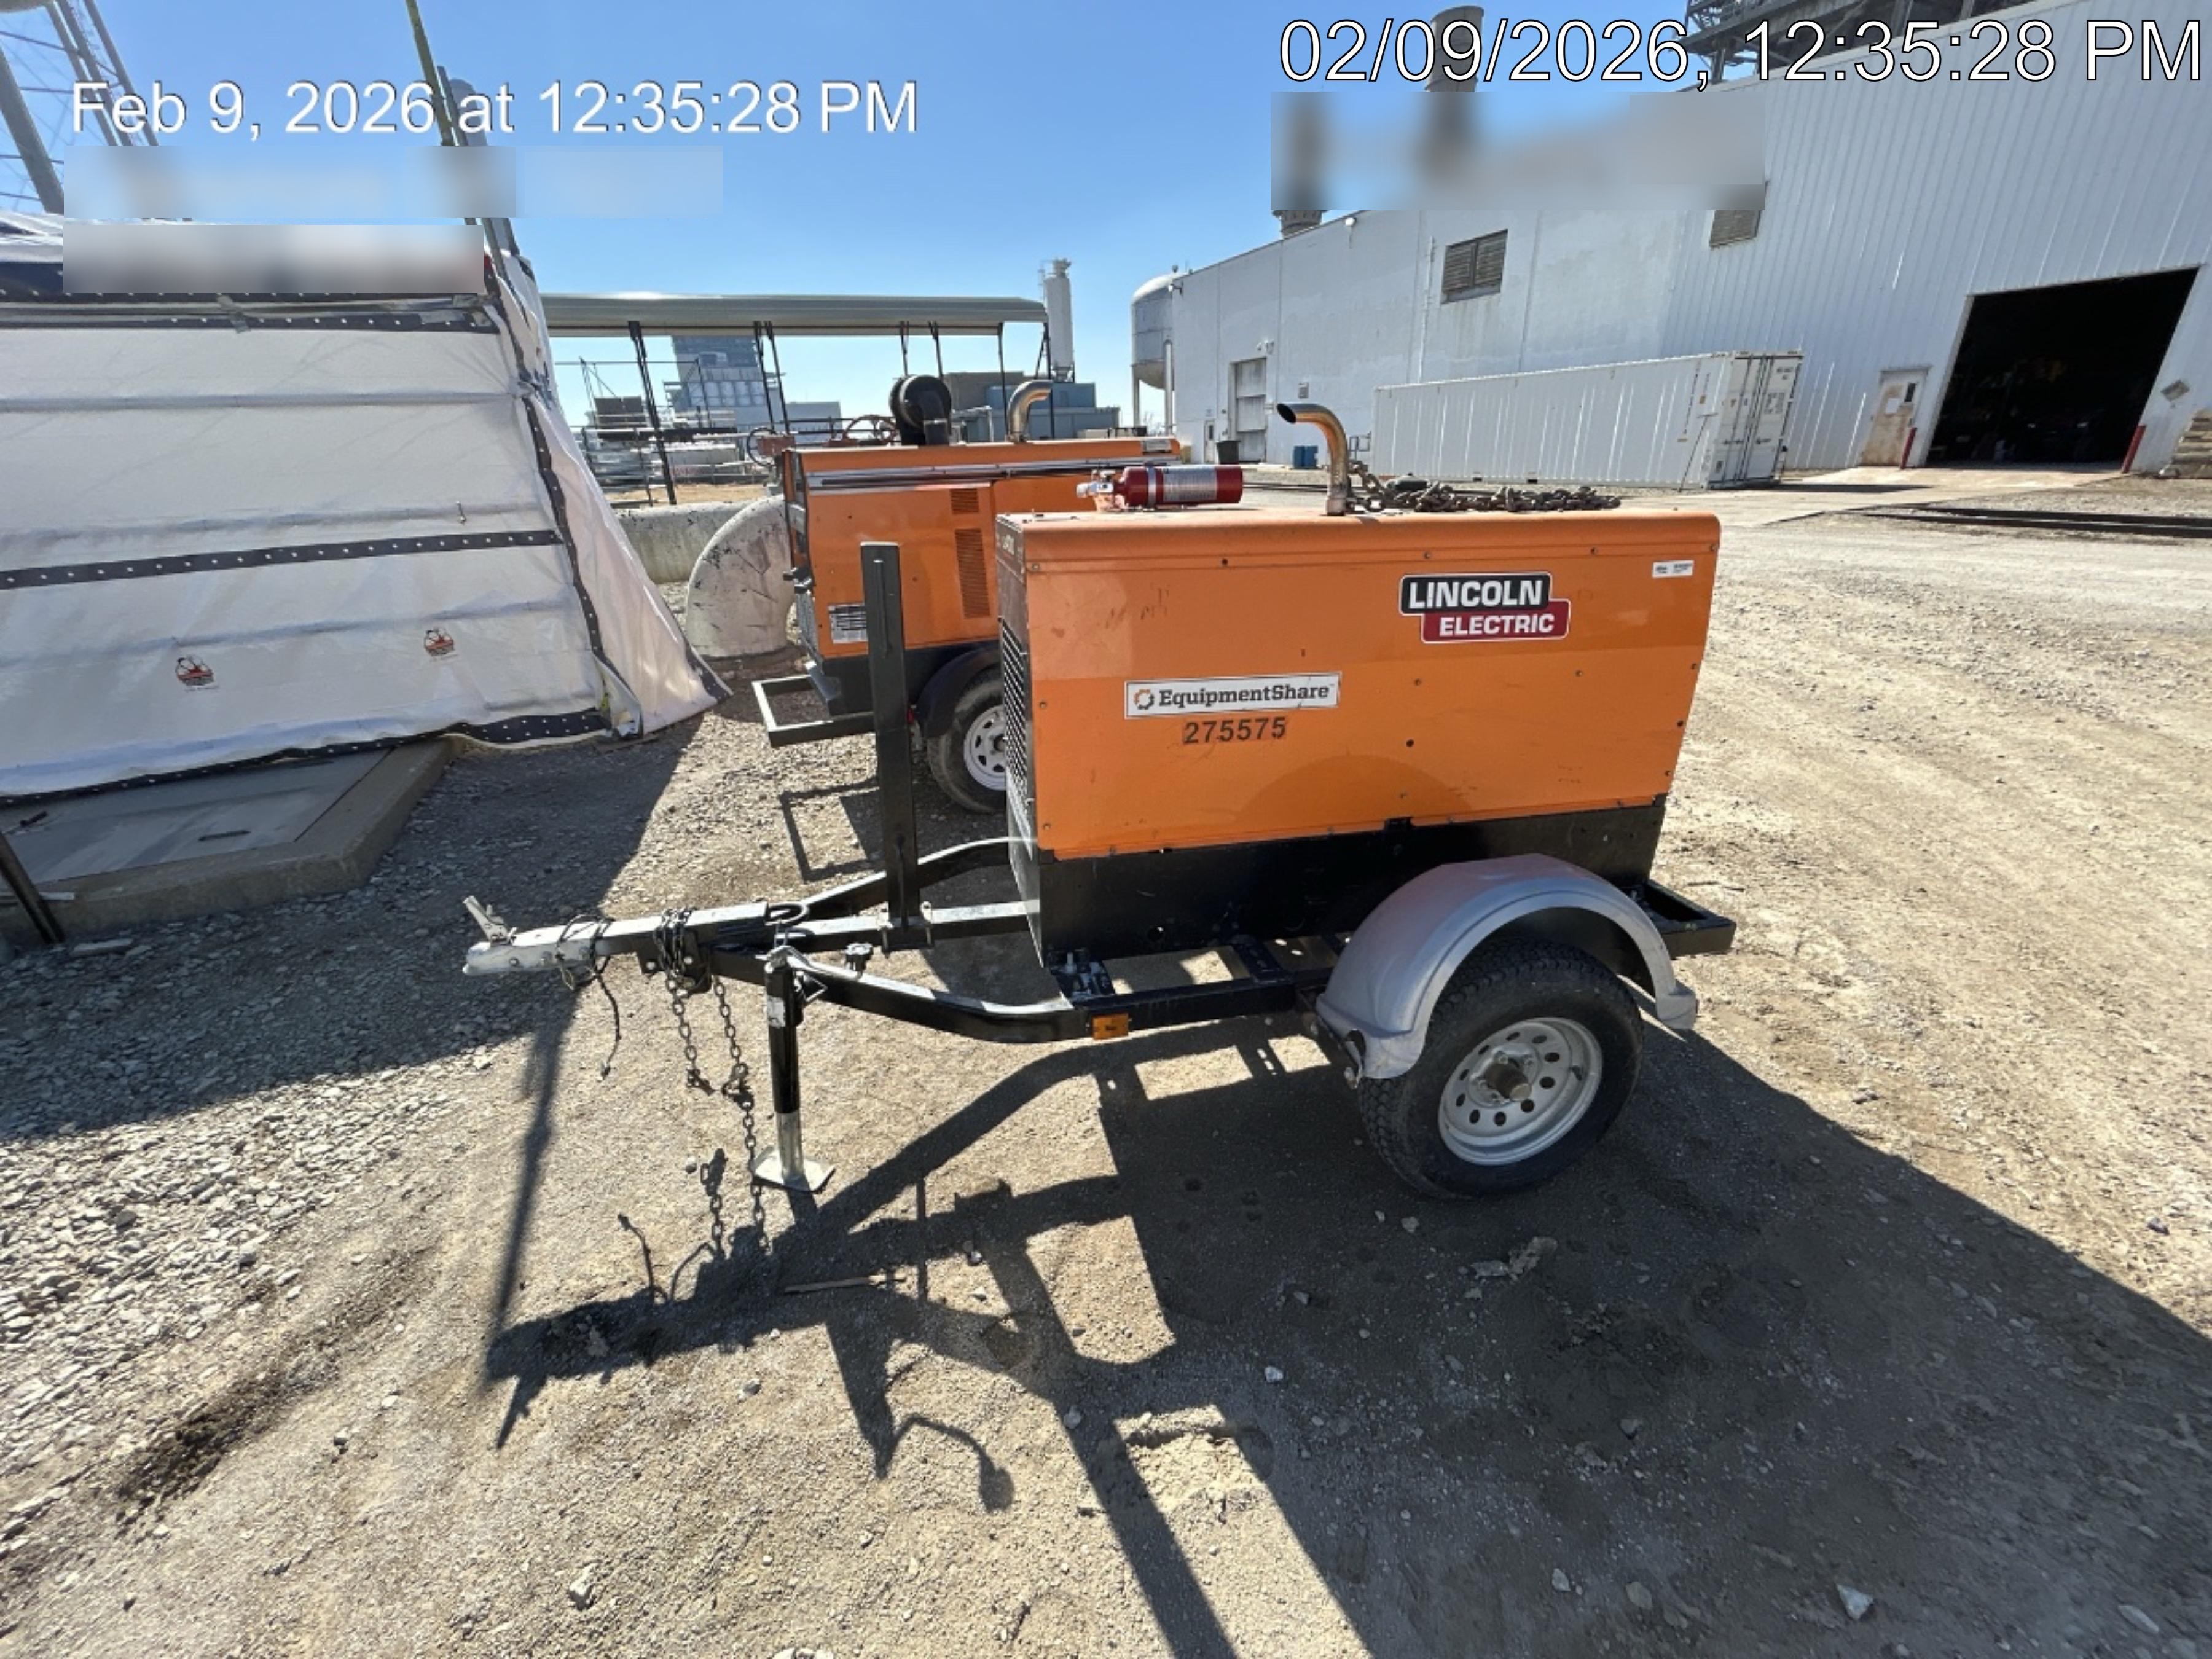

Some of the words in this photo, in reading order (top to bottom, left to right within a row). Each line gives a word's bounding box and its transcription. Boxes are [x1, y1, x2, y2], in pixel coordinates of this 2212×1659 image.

[1408, 579, 1543, 610] LINCOLN
[1439, 613, 1555, 637] ELECTRIC
[1158, 684, 1330, 708] EquipmentShare
[1182, 716, 1287, 745] 275575
